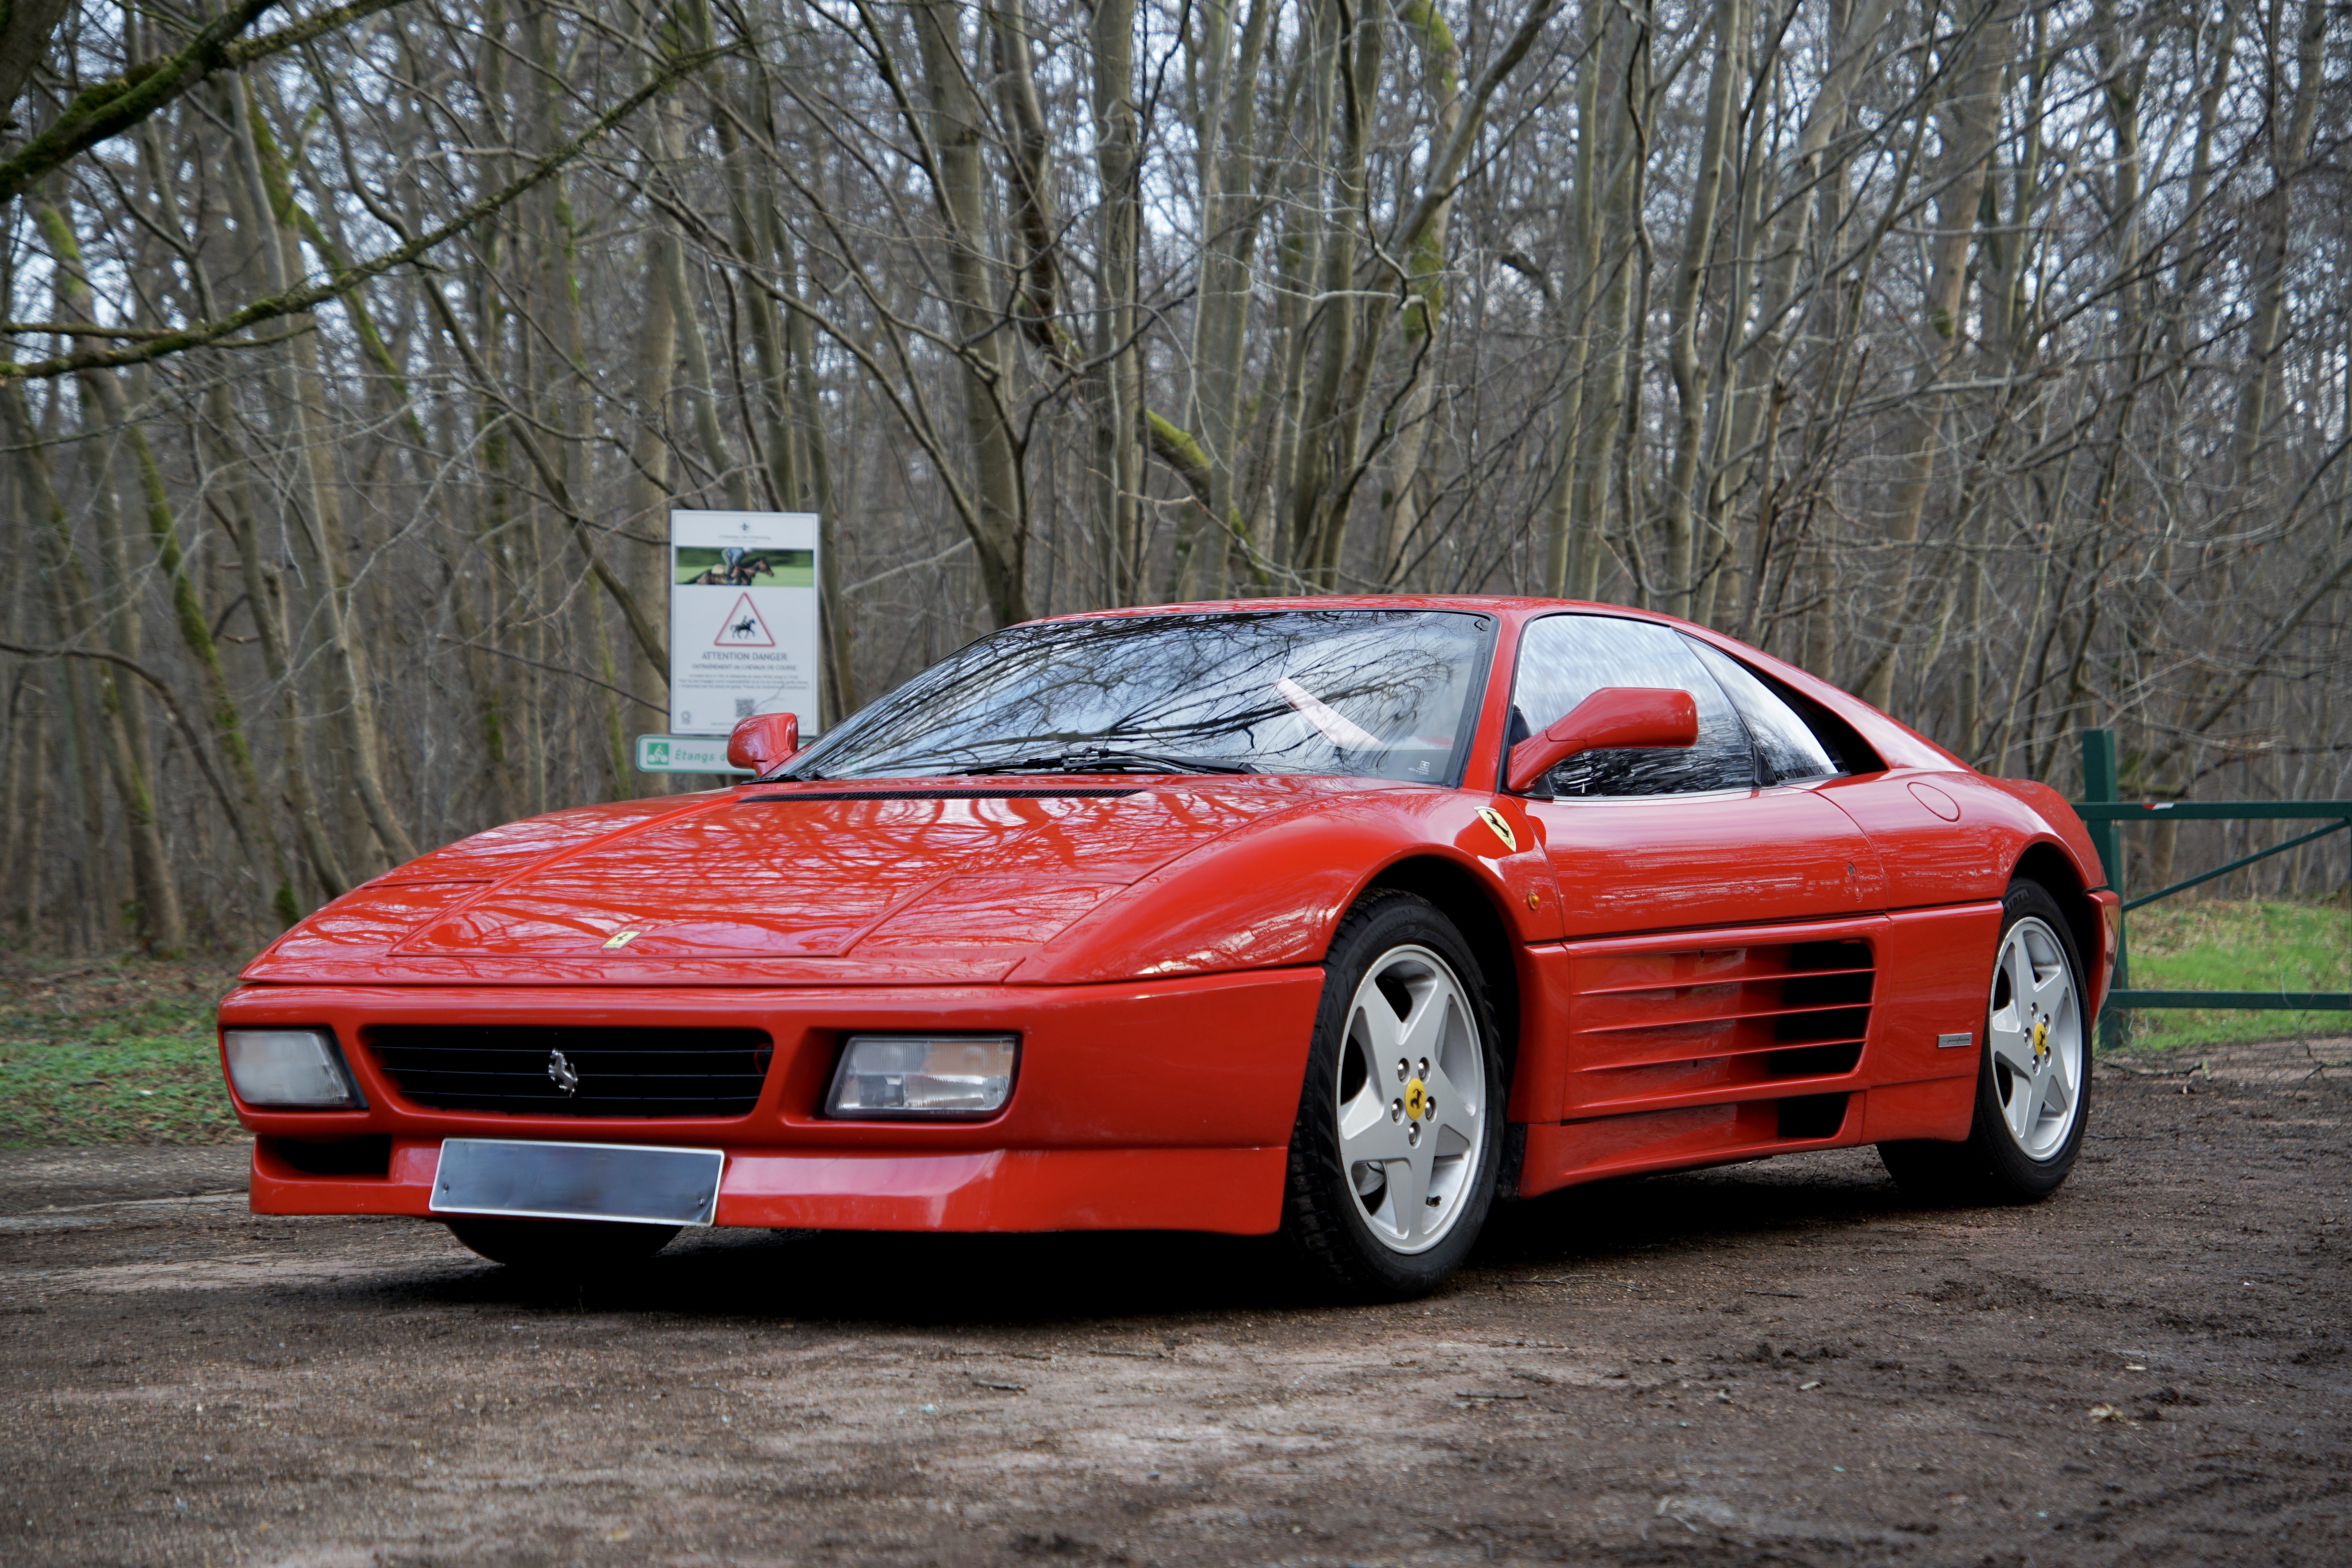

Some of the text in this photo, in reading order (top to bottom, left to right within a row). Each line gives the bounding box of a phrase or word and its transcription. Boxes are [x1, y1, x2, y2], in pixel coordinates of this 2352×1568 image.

[701, 651, 787, 661] ATTENTION DANGER
[675, 748, 727, 763] Étangs d
